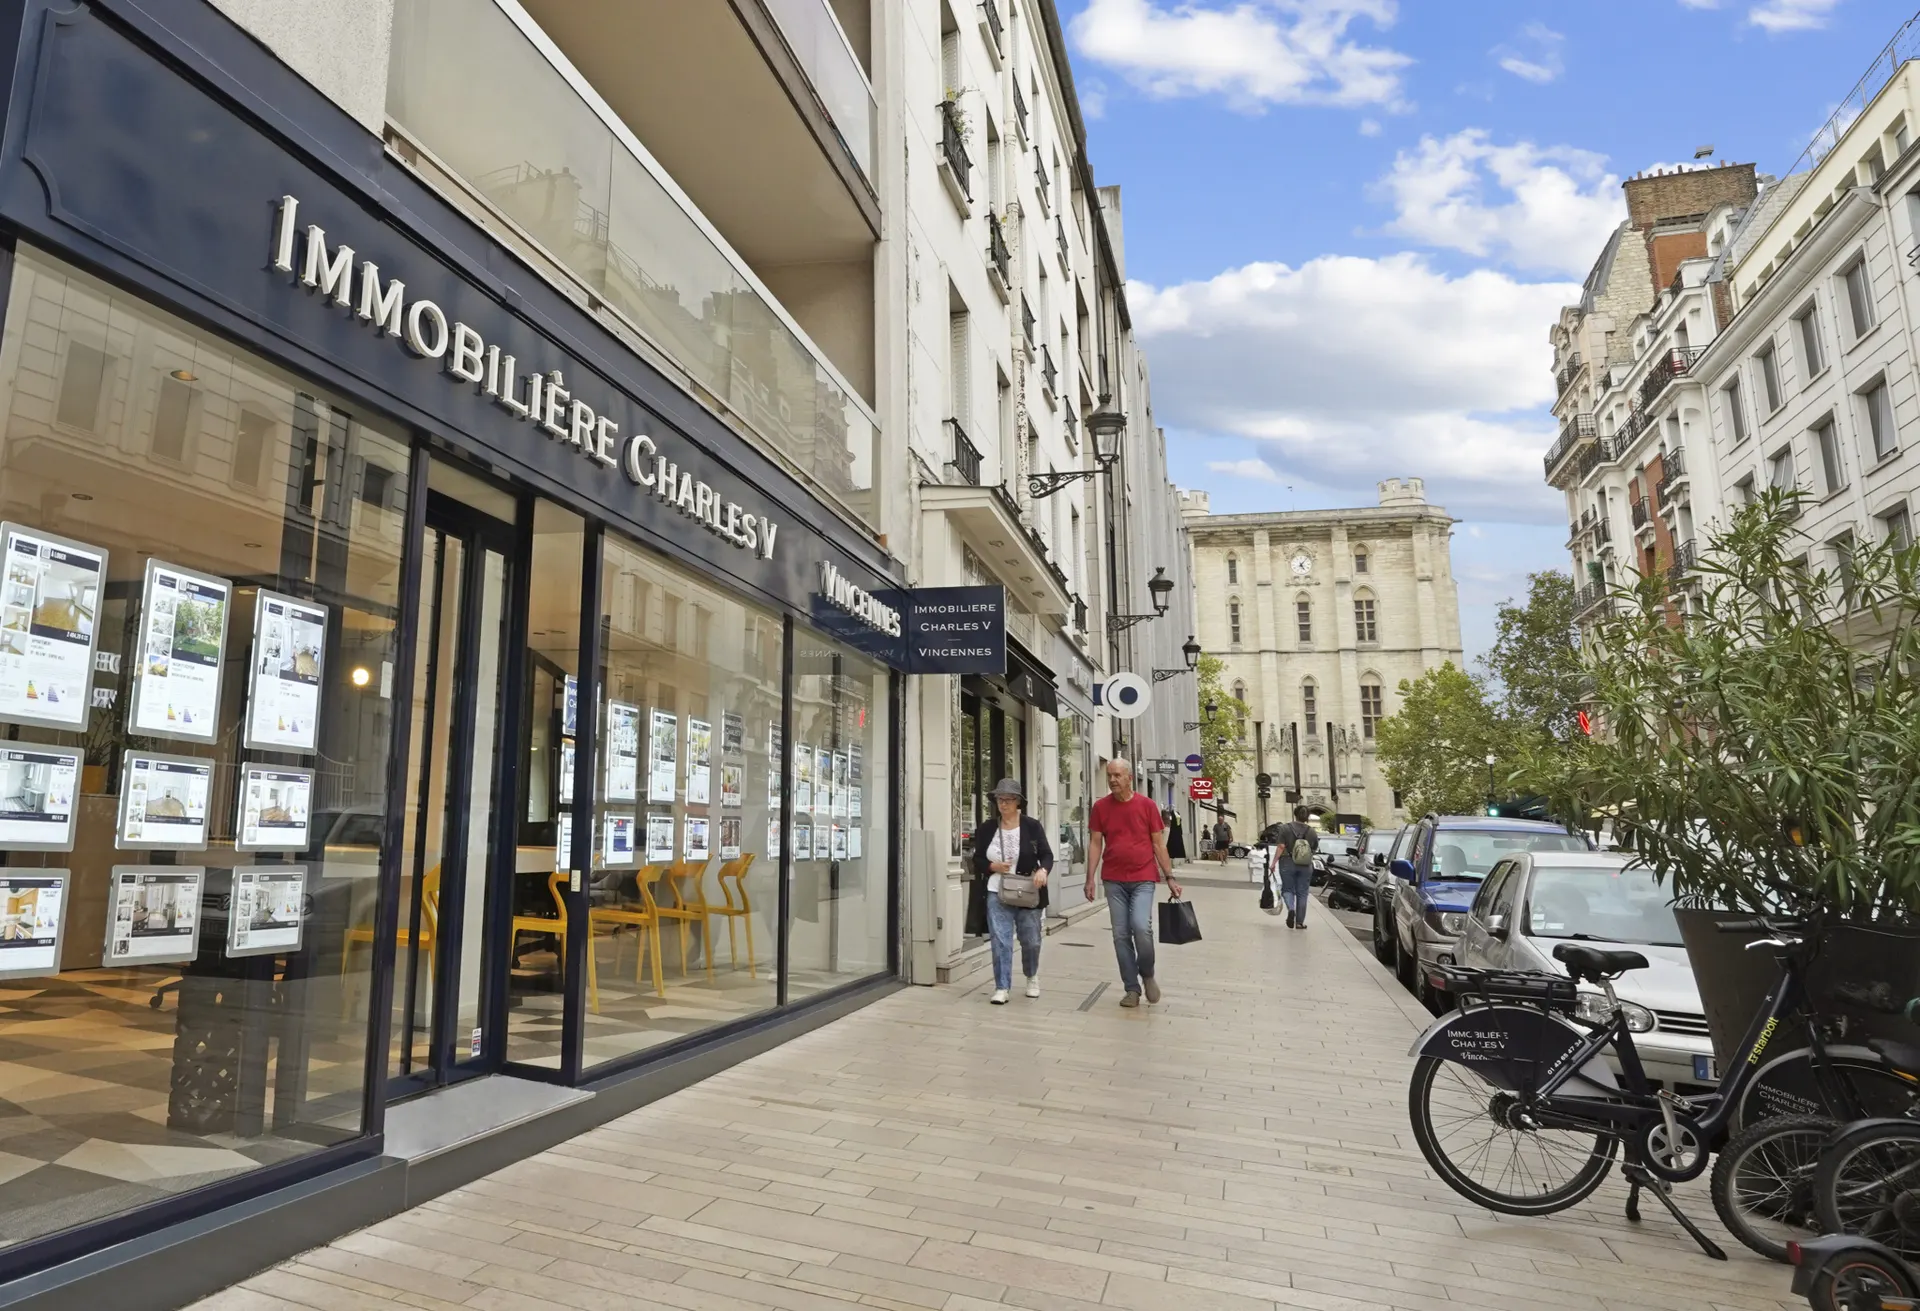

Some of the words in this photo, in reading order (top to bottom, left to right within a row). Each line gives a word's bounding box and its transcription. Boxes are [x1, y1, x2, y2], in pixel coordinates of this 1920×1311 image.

[275, 194, 619, 468] IMMOBILIÈRE
[630, 434, 757, 549] CHARLES
[760, 516, 778, 560] V
[823, 560, 901, 637] VINCENNES
[914, 603, 997, 614] IMMOBILIERE
[920, 622, 979, 632] CHARLES
[982, 621, 992, 630] V
[918, 647, 992, 657] VINCENNES
[1752, 1016, 1780, 1056] starbolt
[1547, 1067, 1555, 1075] 01
[1759, 1090, 1806, 1112] CHARLES
[1807, 1107, 1816, 1115] V
